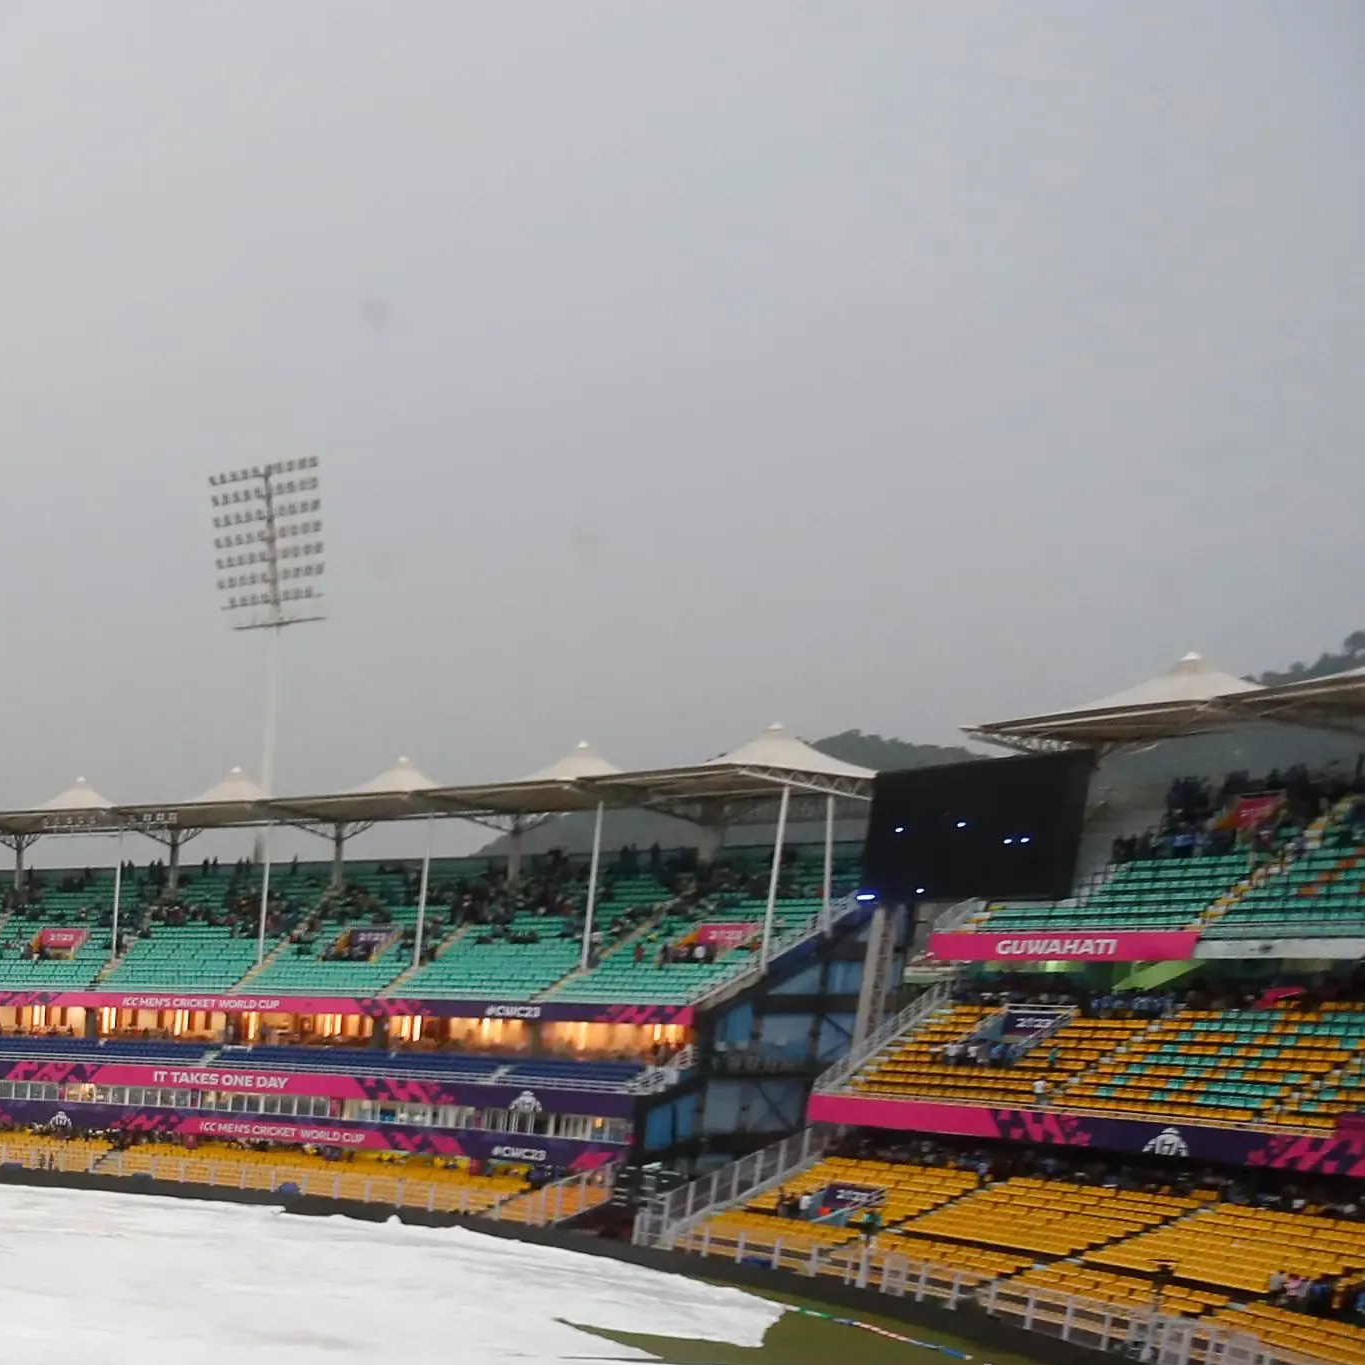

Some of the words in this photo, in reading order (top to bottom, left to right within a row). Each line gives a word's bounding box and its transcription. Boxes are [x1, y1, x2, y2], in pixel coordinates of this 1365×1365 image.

[996, 939, 1117, 954] GUWAHATI
[122, 997, 137, 1006] ICC
[137, 997, 170, 1007] MEN'S
[170, 998, 215, 1010] CRICKET
[216, 1000, 254, 1009] WORLD
[254, 1000, 279, 1009] CUP
[484, 1006, 540, 1020] #CWC23
[154, 1071, 168, 1082] IT
[171, 1072, 219, 1084] TAKES
[222, 1074, 254, 1087] ONE
[256, 1076, 288, 1088] DAY
[200, 1122, 215, 1131] ICC
[215, 1123, 250, 1134] MEN'S
[250, 1125, 297, 1139] CRICKET
[300, 1129, 341, 1141] WORLD
[341, 1133, 365, 1143] CUP
[491, 1146, 546, 1163] #CWC23
